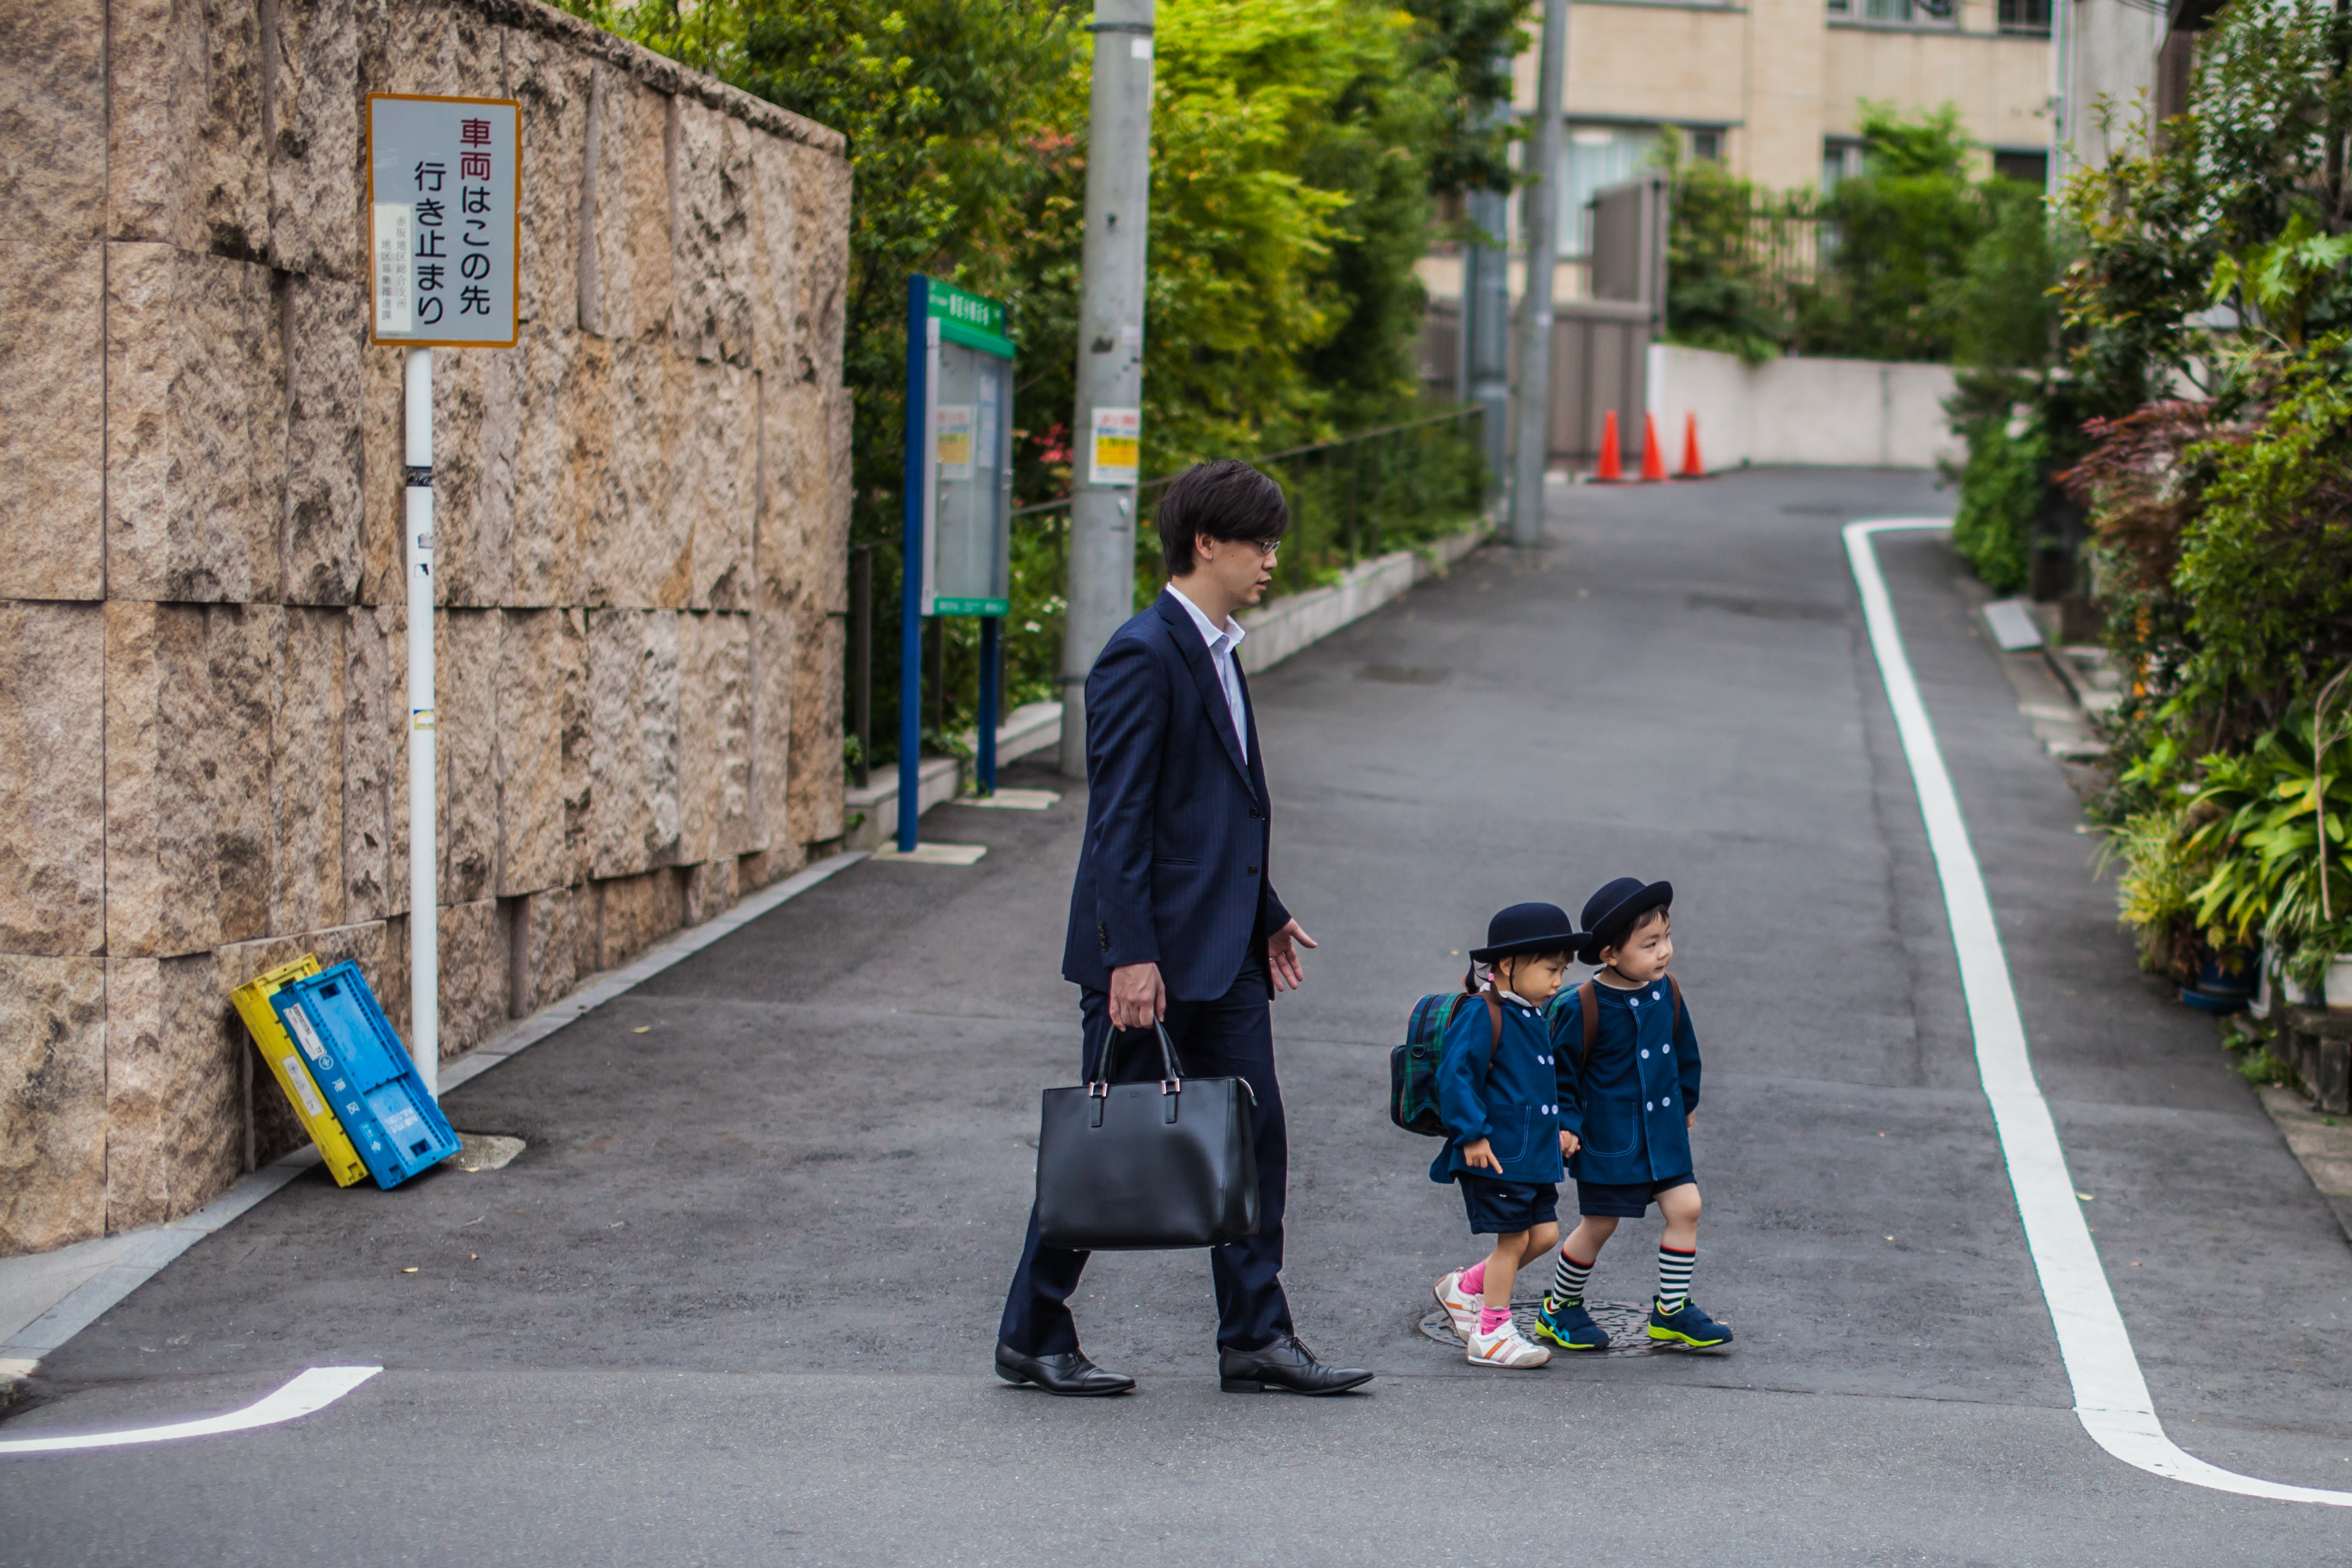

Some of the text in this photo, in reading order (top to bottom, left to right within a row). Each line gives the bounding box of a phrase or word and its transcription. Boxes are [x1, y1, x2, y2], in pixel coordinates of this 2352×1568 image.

[415, 161, 446, 324] 行き止まり
[460, 118, 492, 315] 車両はこの先
